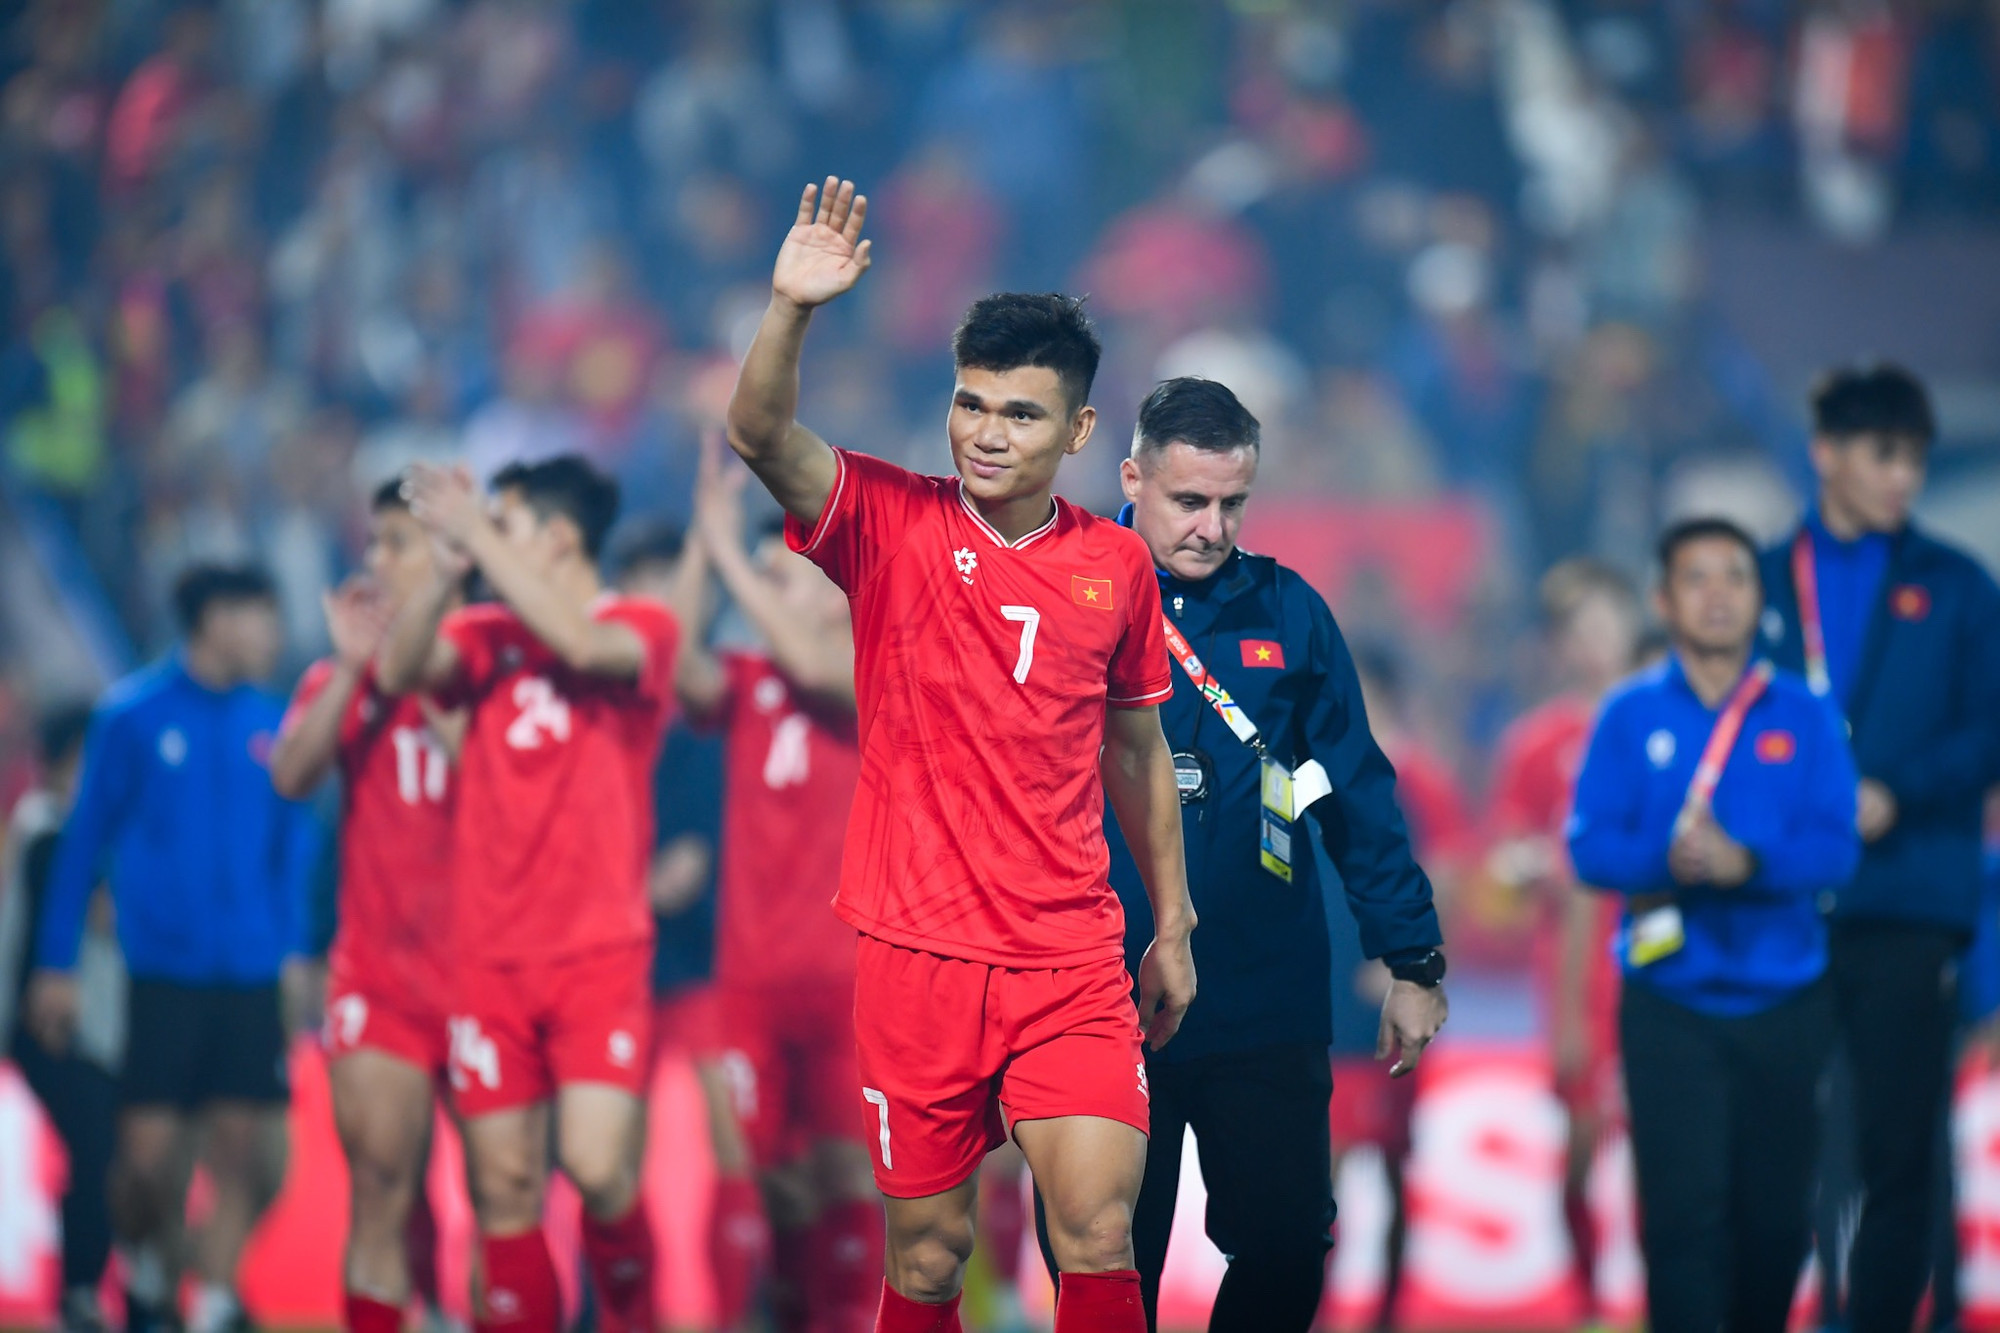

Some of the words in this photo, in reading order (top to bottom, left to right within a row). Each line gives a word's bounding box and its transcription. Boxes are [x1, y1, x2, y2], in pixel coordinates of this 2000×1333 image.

[1000, 604, 1041, 685] 7
[1169, 635, 1187, 655] 2024
[506, 673, 571, 749] 24
[862, 1086, 893, 1171] 7
